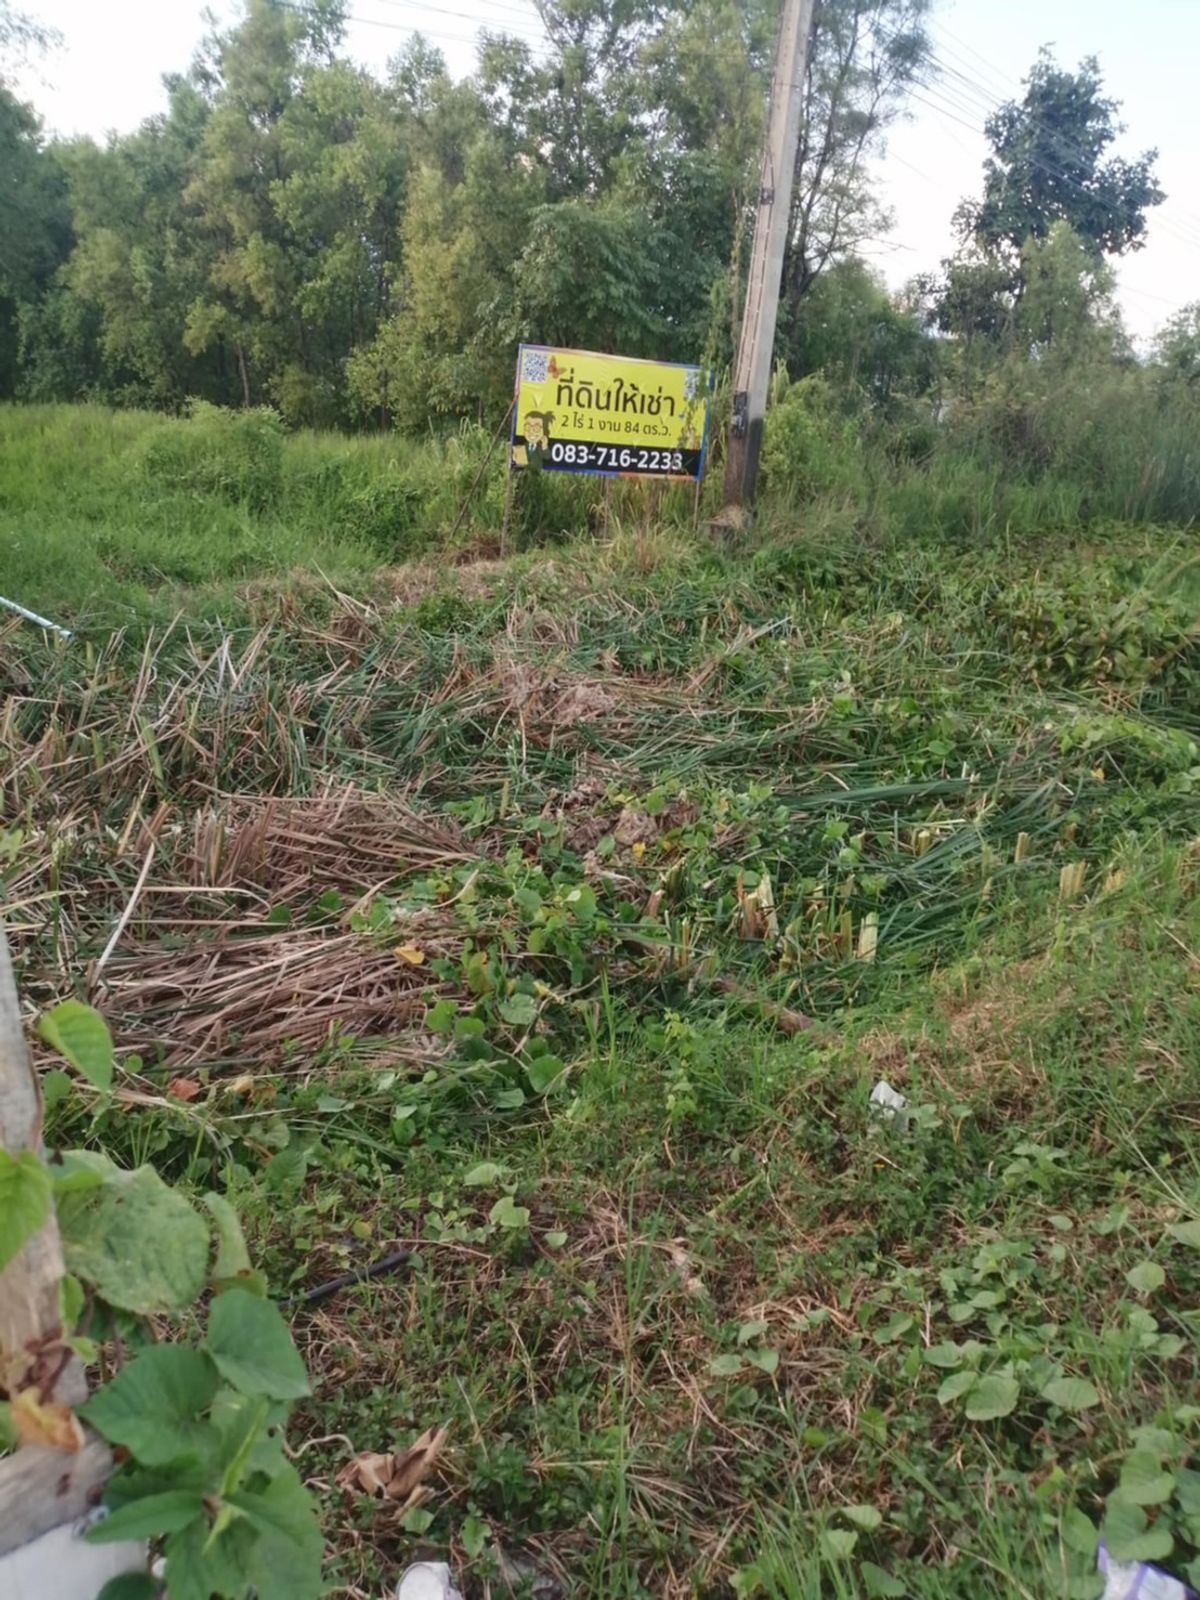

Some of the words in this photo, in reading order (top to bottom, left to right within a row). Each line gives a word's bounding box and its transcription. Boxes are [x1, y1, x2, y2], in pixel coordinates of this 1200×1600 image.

[556, 368, 675, 416] ที่ดินให้เช่า
[561, 415, 569, 427] 2
[573, 412, 583, 429] ไร่
[587, 418, 594, 429] 1
[599, 420, 621, 432] งาน
[624, 422, 639, 433] 84
